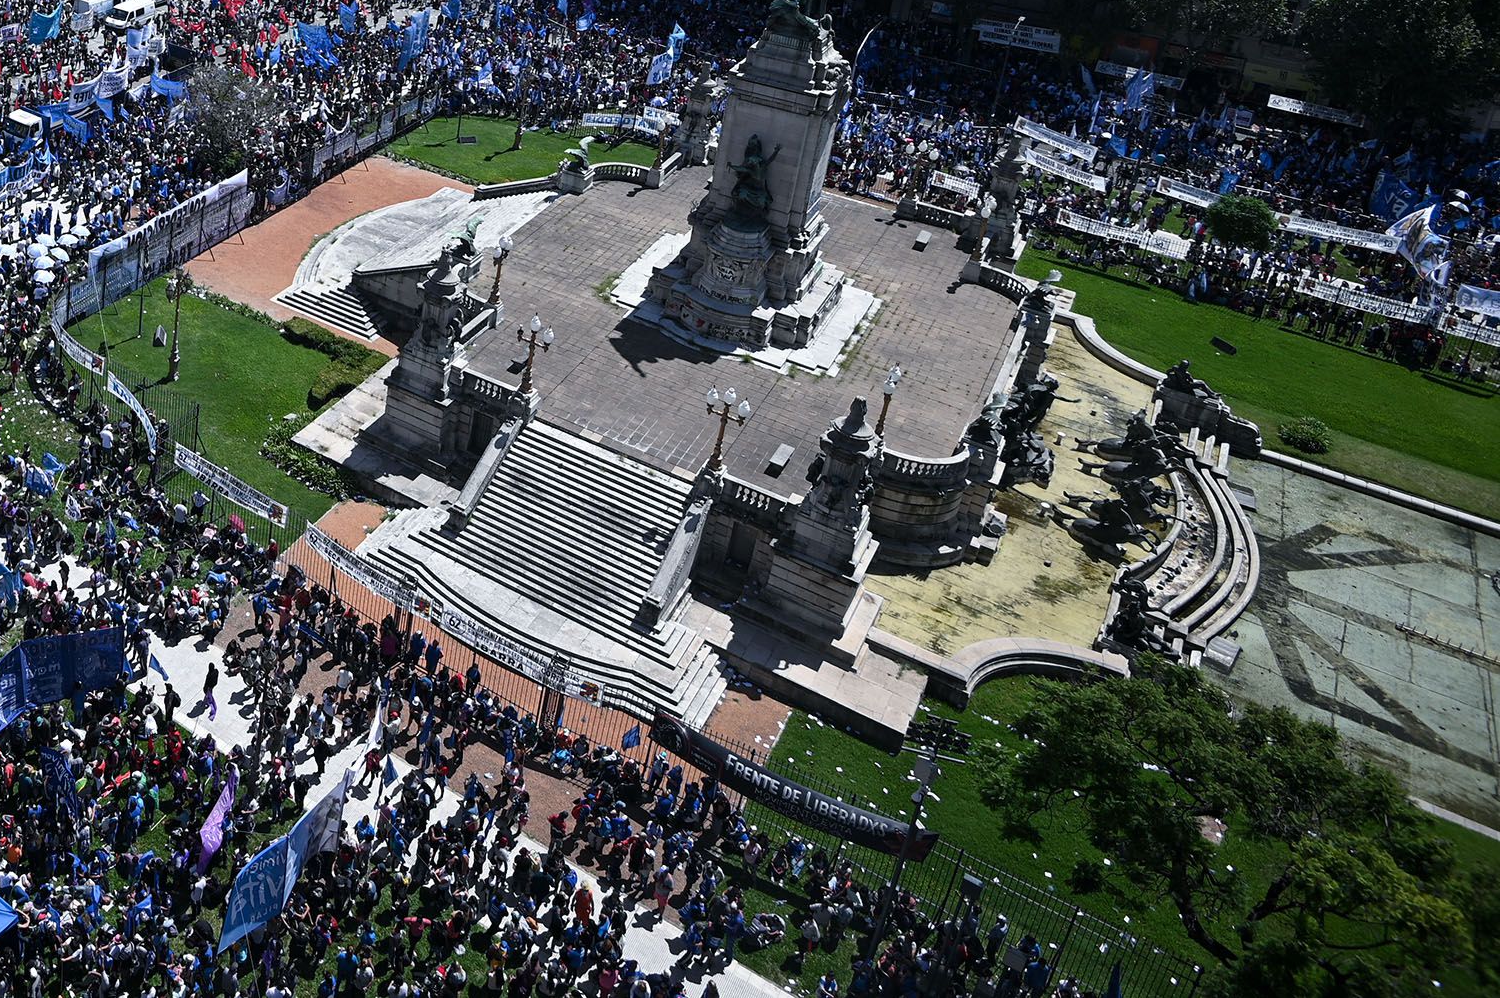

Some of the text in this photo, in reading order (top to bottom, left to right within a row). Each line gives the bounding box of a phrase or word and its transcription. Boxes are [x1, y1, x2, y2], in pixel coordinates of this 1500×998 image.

[178, 452, 188, 463] 62
[195, 471, 230, 498] IBARRA
[309, 533, 318, 544] 62
[324, 546, 341, 563] SECA
[448, 615, 461, 630] 62
[467, 619, 477, 630] 62
[477, 625, 519, 652] ORGANIZACIONES
[466, 641, 514, 672] IBARRA
[725, 753, 779, 791] FRENTE
[781, 783, 803, 804] DE
[803, 790, 889, 838] LIBERADXS
[753, 788, 822, 823] MOVIMIENTO
